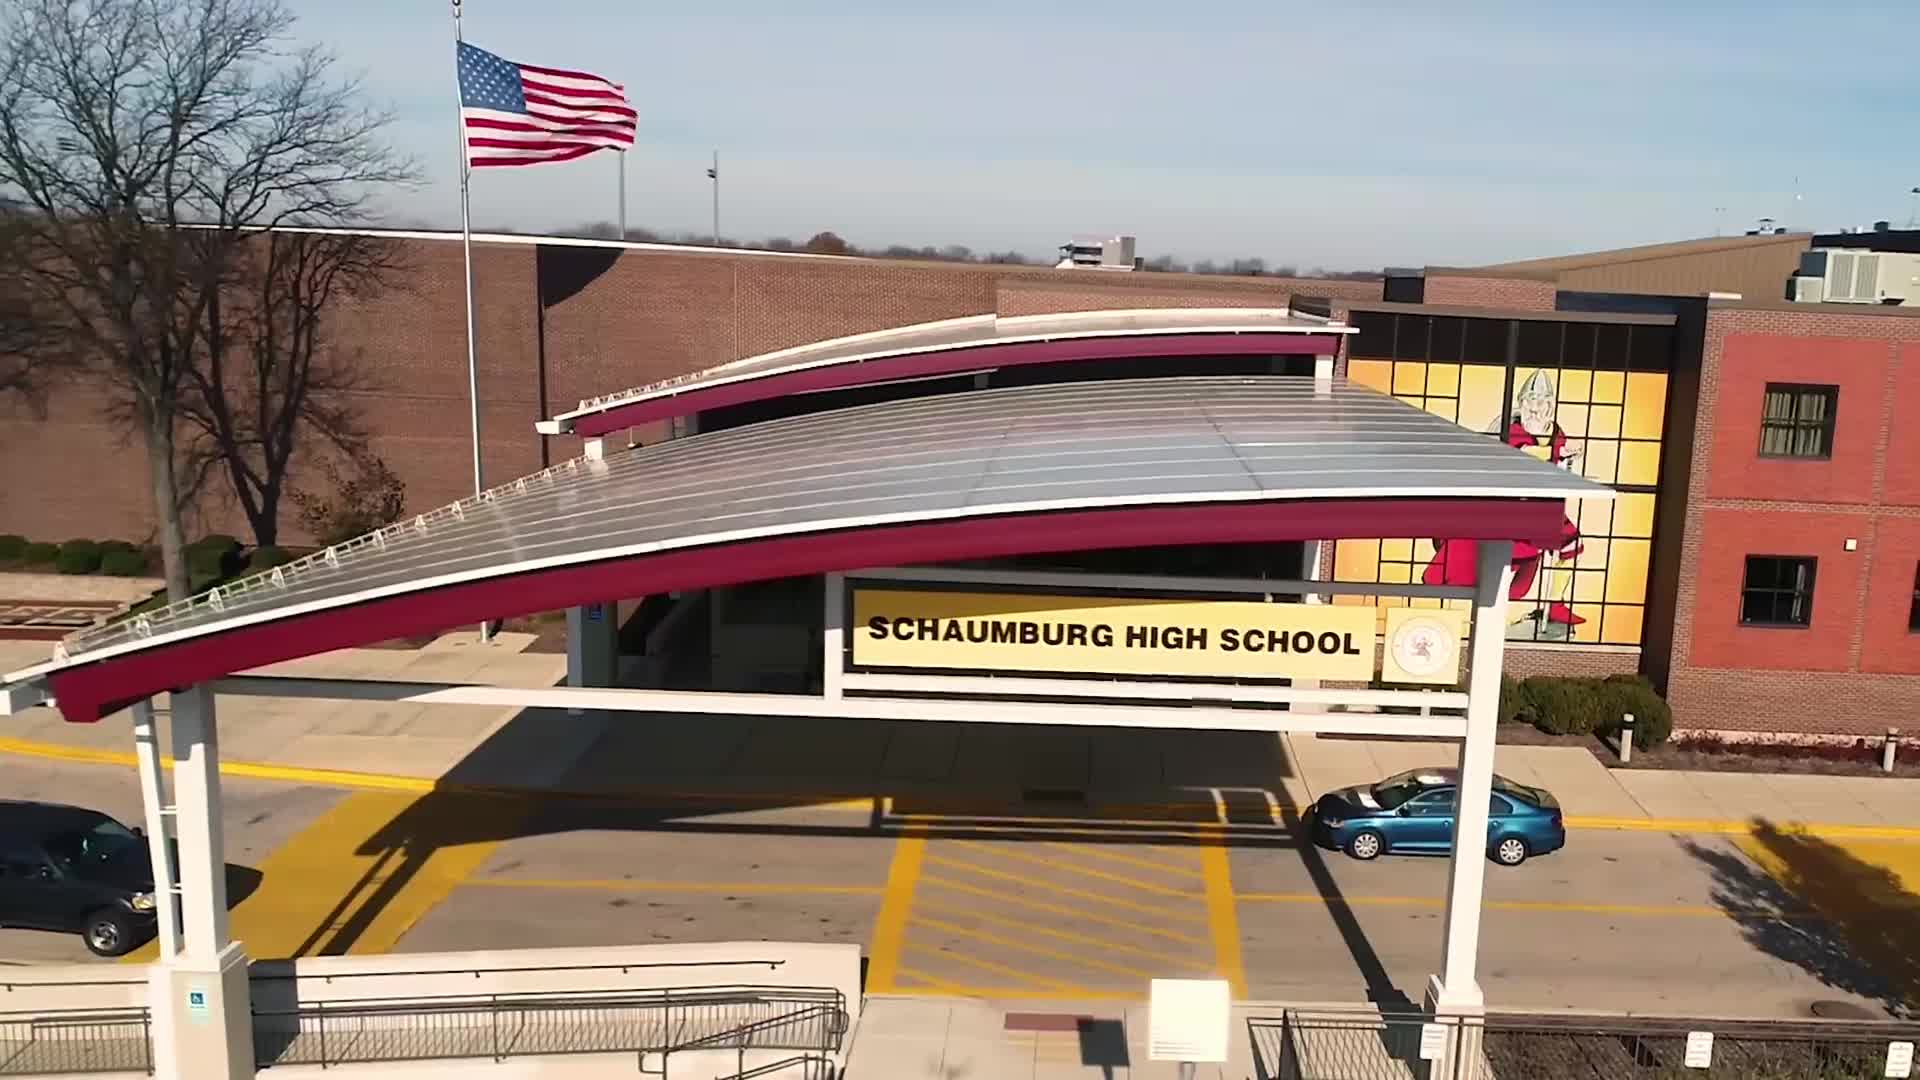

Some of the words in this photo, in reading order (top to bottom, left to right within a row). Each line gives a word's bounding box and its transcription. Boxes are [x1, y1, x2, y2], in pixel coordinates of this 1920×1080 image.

[867, 615, 1114, 648] SCHAUMBURG
[1126, 625, 1207, 650] HIGH
[1220, 628, 1361, 655] SCHOOL
